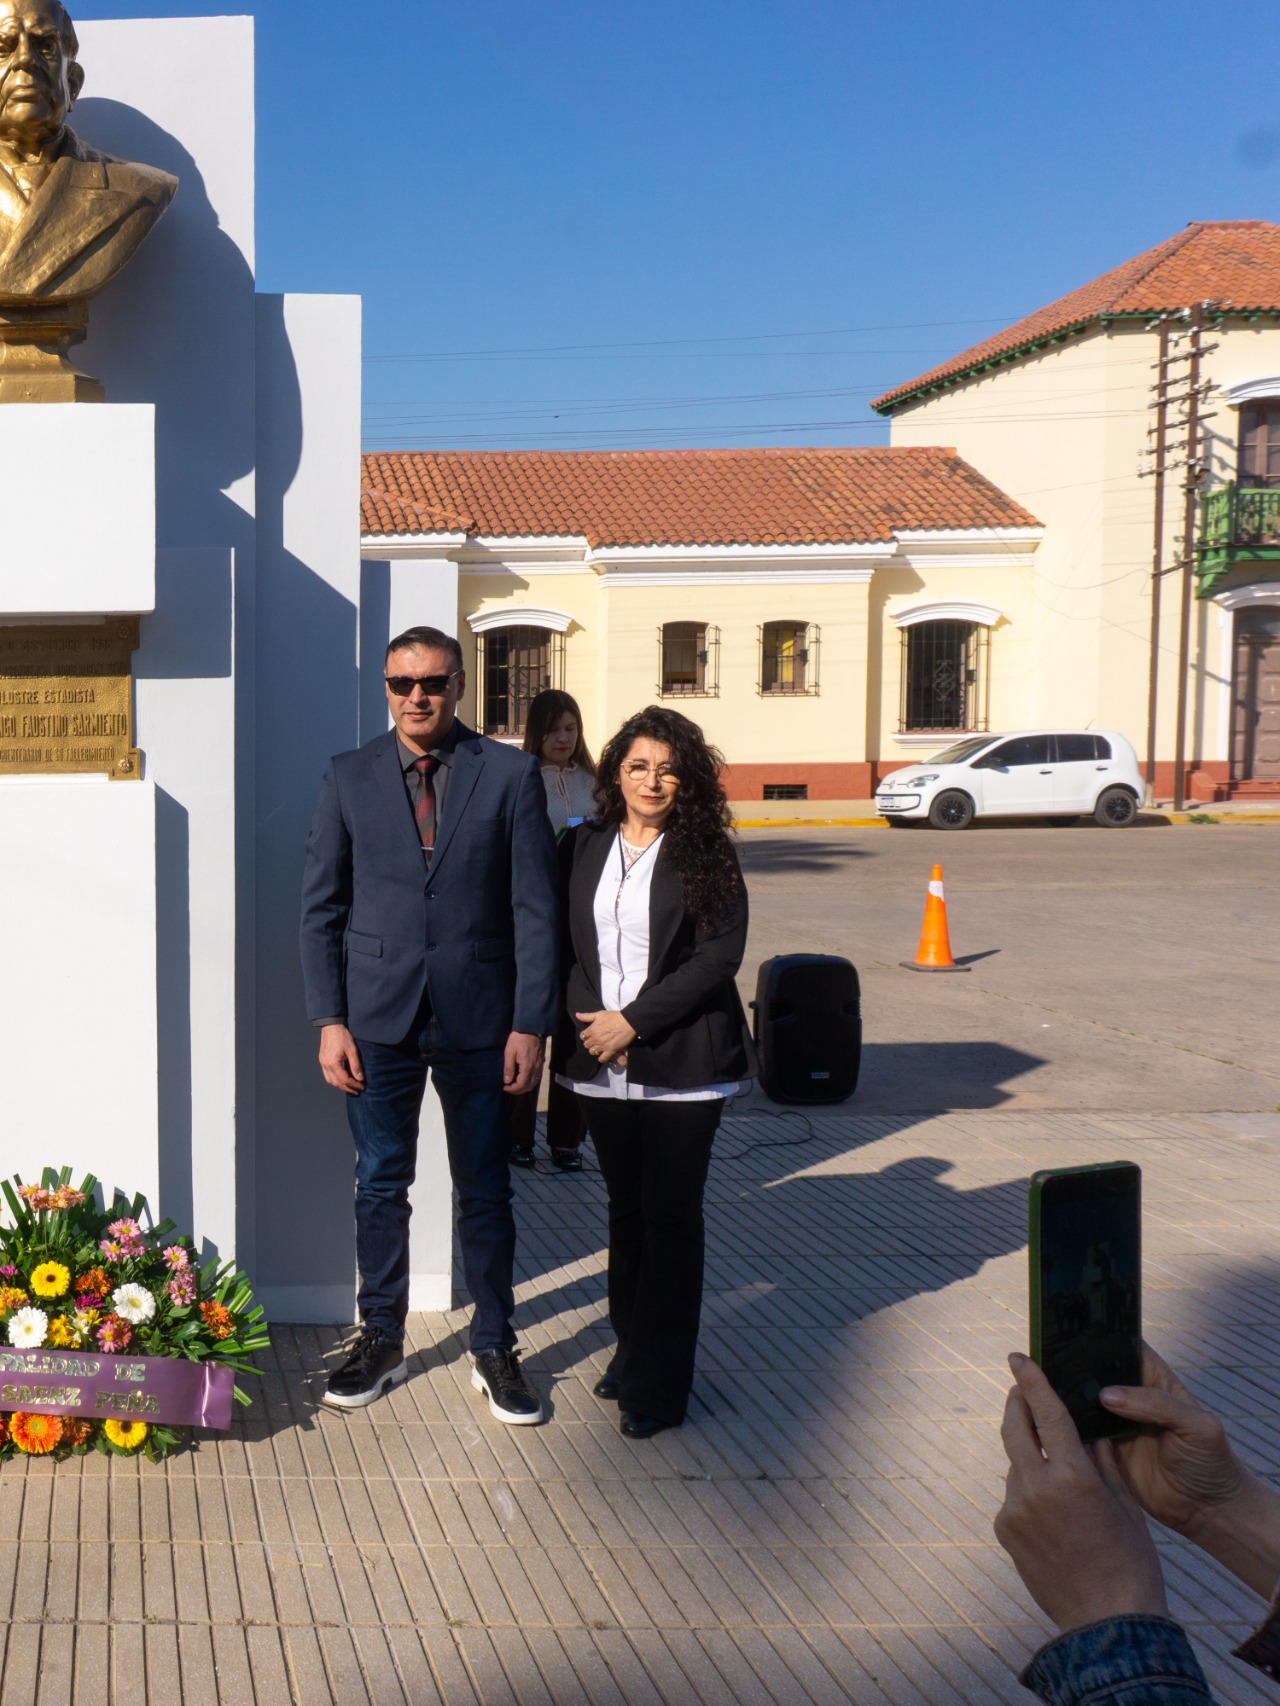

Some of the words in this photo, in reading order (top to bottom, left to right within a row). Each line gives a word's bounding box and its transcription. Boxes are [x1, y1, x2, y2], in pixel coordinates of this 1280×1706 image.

[44, 688, 95, 704] ESTADISTA
[22, 714, 68, 737] FAUSTINO
[72, 713, 127, 737] SARMIENTO
[45, 747, 53, 762] DE
[66, 746, 116, 761] FALLECIMIENTO
[114, 1363, 146, 1382] DE
[1, 1384, 82, 1407] SAENZ
[95, 1389, 161, 1414] PEÑA
